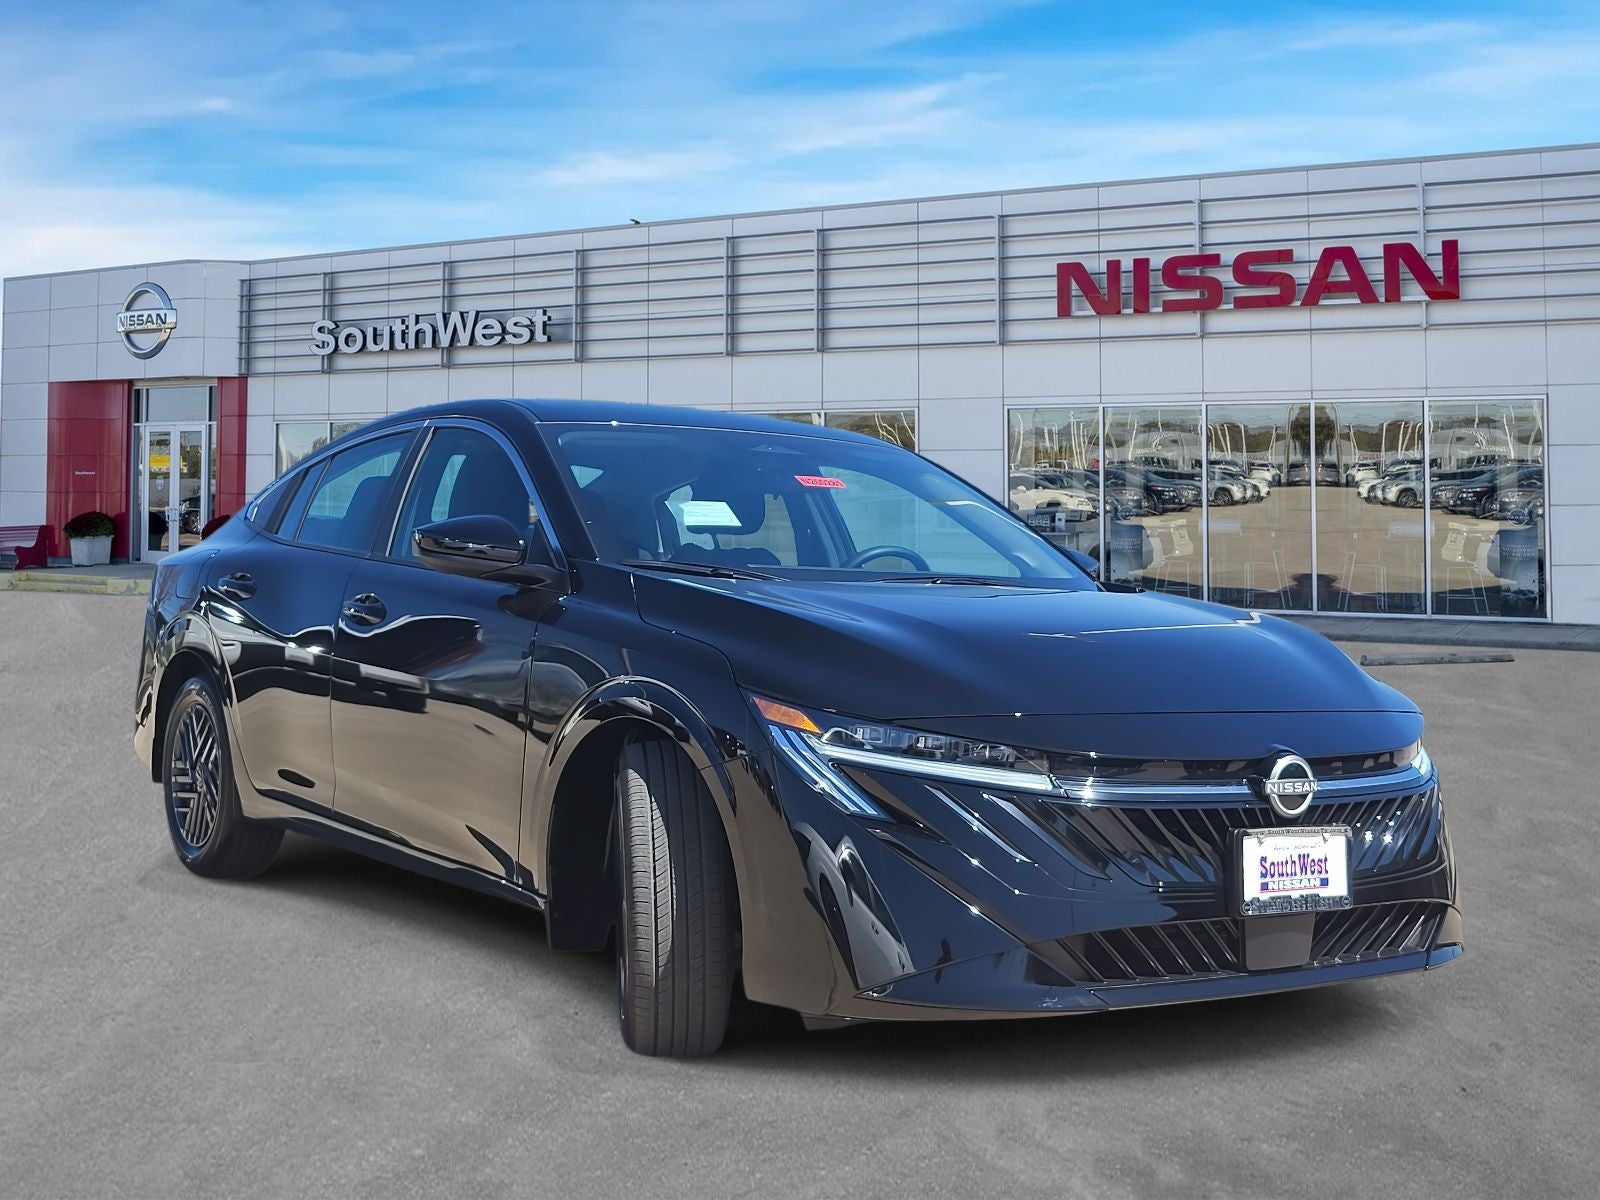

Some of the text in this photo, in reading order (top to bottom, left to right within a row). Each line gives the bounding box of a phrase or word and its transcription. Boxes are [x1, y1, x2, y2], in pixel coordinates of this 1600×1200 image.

[1056, 239, 1460, 317] NISSAN
[119, 312, 167, 328] NISSAN
[308, 309, 551, 355] SouthWest
[1267, 780, 1318, 794] NISSAN
[1260, 852, 1329, 879] SouthWest
[1267, 878, 1321, 891] NISSAN
